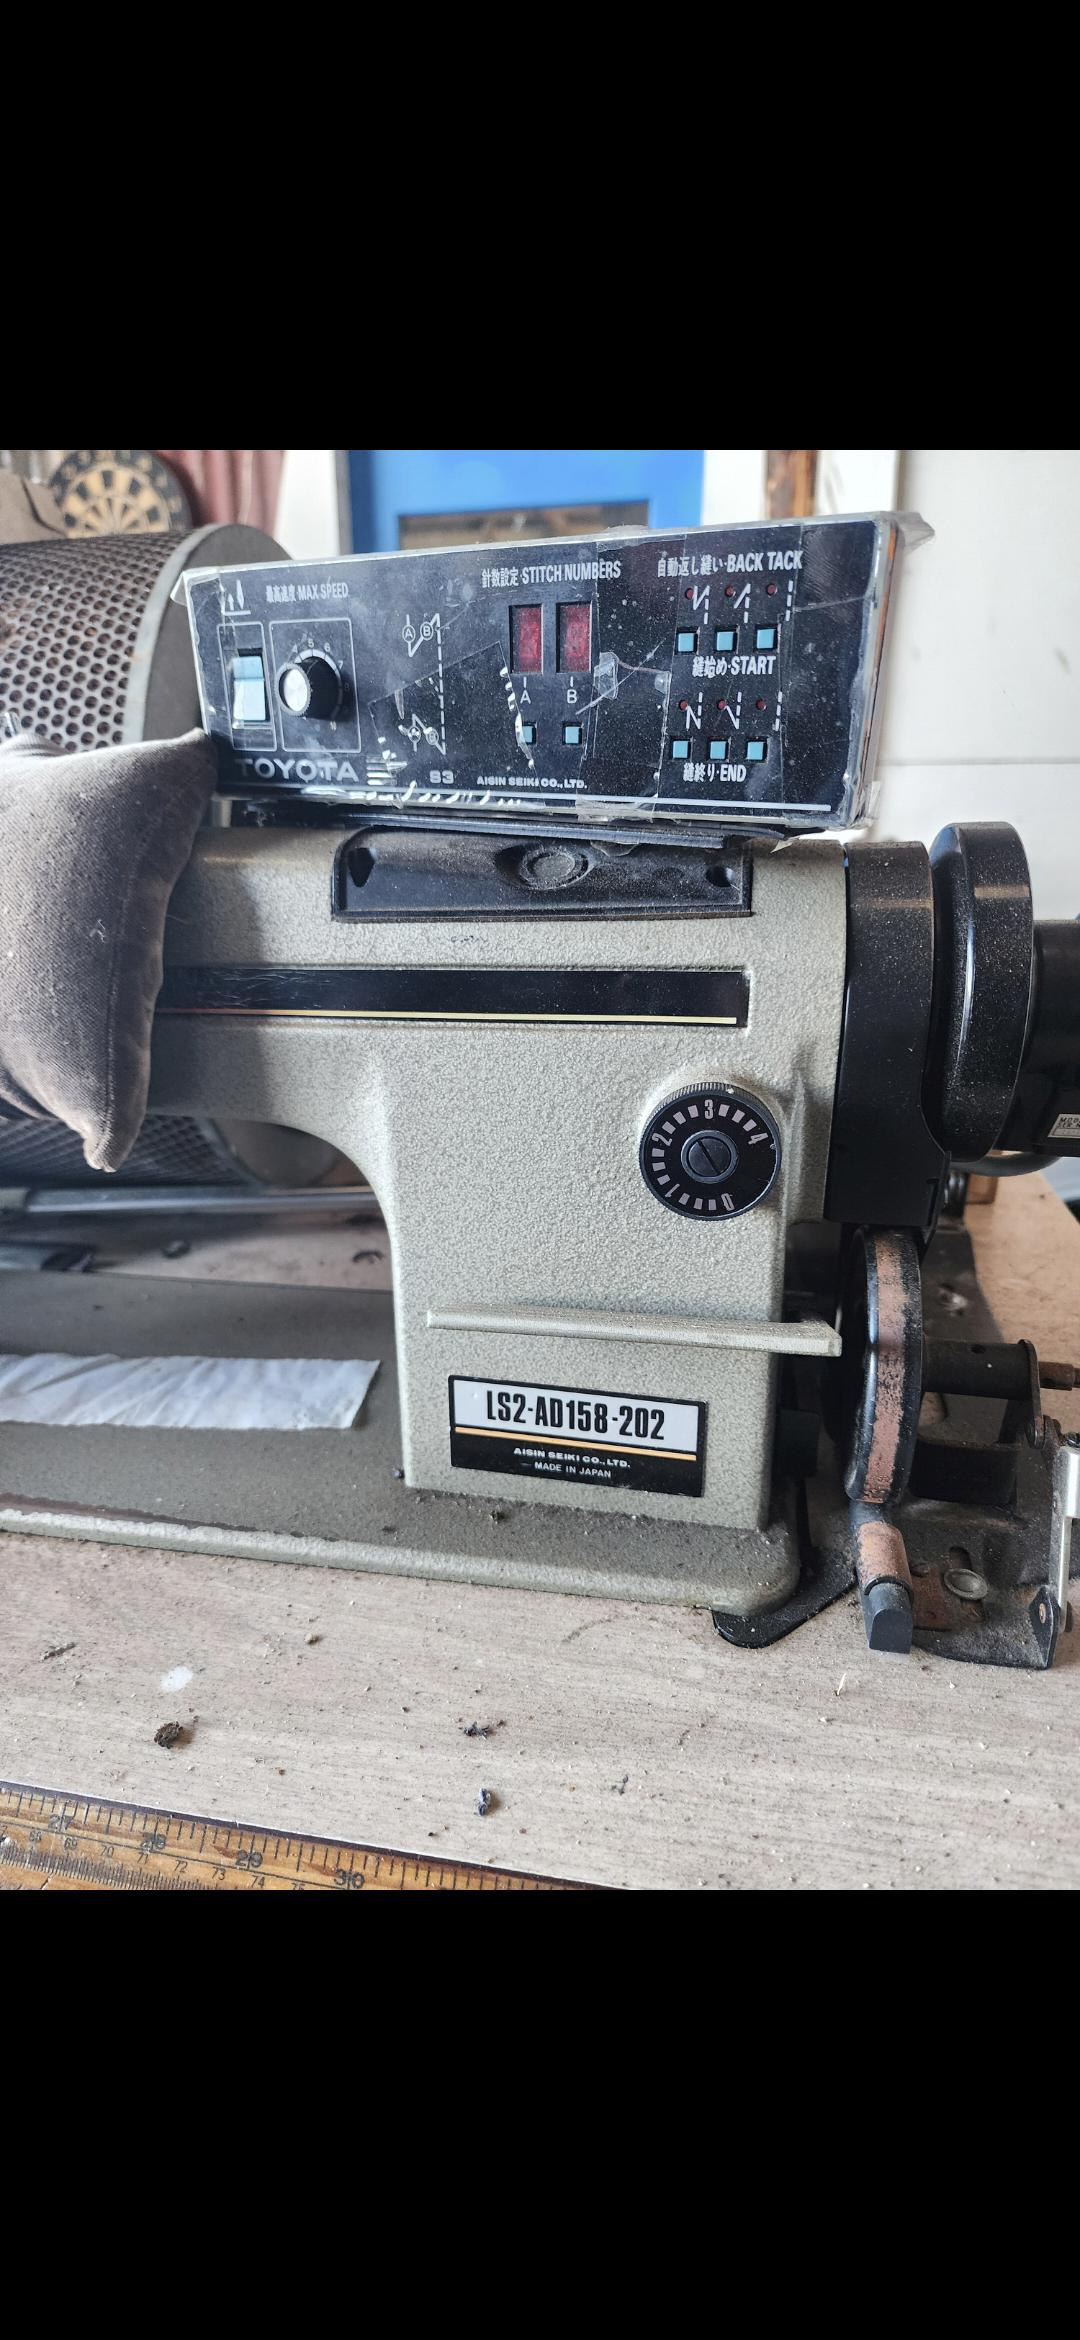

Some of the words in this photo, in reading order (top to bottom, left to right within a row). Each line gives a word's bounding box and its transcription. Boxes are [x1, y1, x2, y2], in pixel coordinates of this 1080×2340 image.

[767, 550, 804, 571] TACK
[564, 560, 622, 581] NUMBERS
[320, 582, 349, 600] SPEED
[520, 690, 532, 704] A
[566, 689, 578, 704] B
[236, 758, 359, 783] TOYOTA
[429, 769, 454, 785] S3
[477, 775, 506, 786] AISIN
[508, 776, 540, 787] SEIKI
[704, 1099, 714, 1119] 3
[651, 1132, 673, 1147] 2
[748, 1132, 769, 1145] 4
[664, 1183, 681, 1198] 1
[721, 1193, 736, 1212] 0
[486, 1389, 665, 1441] LS2-AD158-202
[513, 1447, 546, 1459] AISIN
[548, 1451, 580, 1462] SEIKI
[534, 1461, 562, 1473] MADE
[565, 1464, 576, 1475] IN
[579, 1465, 612, 1479] JAPAN
[48, 1814, 73, 1832] 27
[235, 1849, 263, 1868] 29
[334, 1868, 365, 1889] 30
[101, 1845, 115, 1858] 70
[175, 1859, 188, 1874] 72
[212, 1866, 226, 1881] 73
[251, 1874, 265, 1889] 74
